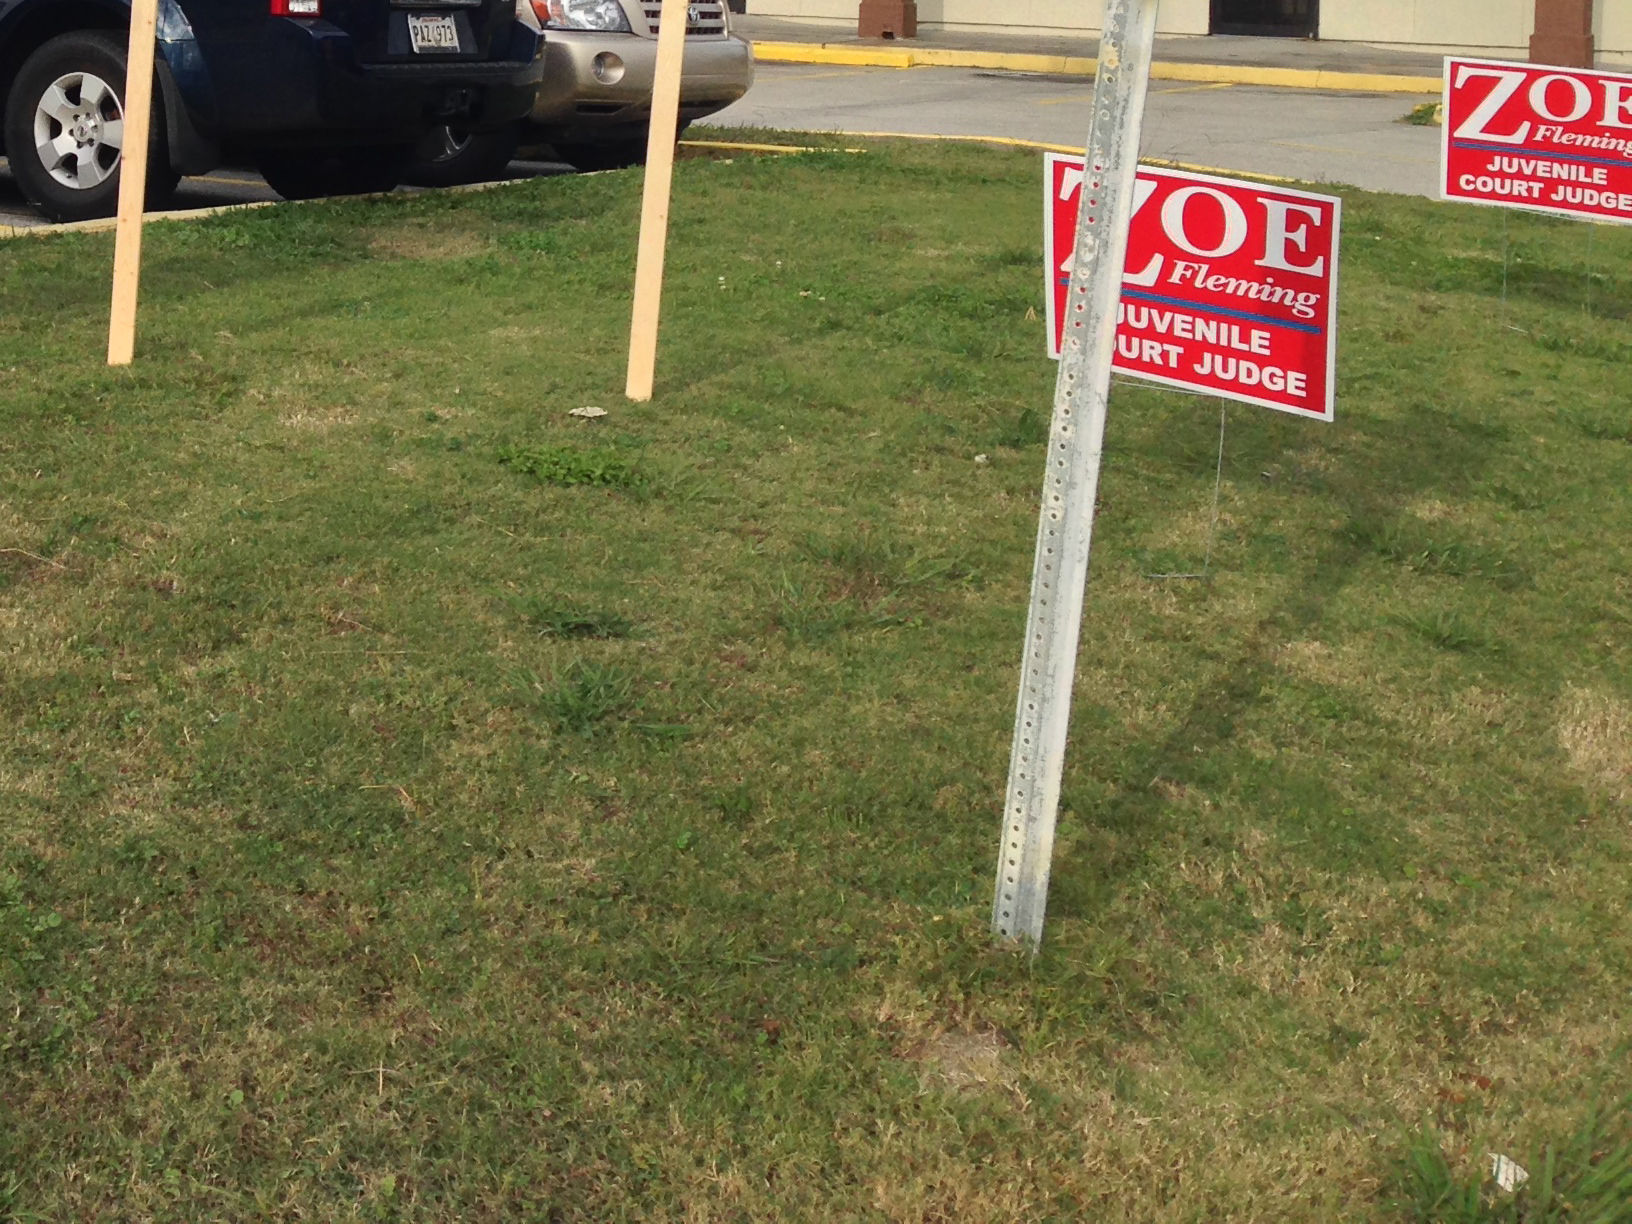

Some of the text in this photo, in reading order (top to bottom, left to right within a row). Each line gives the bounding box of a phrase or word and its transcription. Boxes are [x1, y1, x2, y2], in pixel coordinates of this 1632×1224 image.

[1486, 155, 1608, 185] JUVENILE
[1459, 174, 1632, 211] COURT JUDGE
[1167, 260, 1320, 319] Fleming
[1193, 352, 1307, 397] JUDGE
